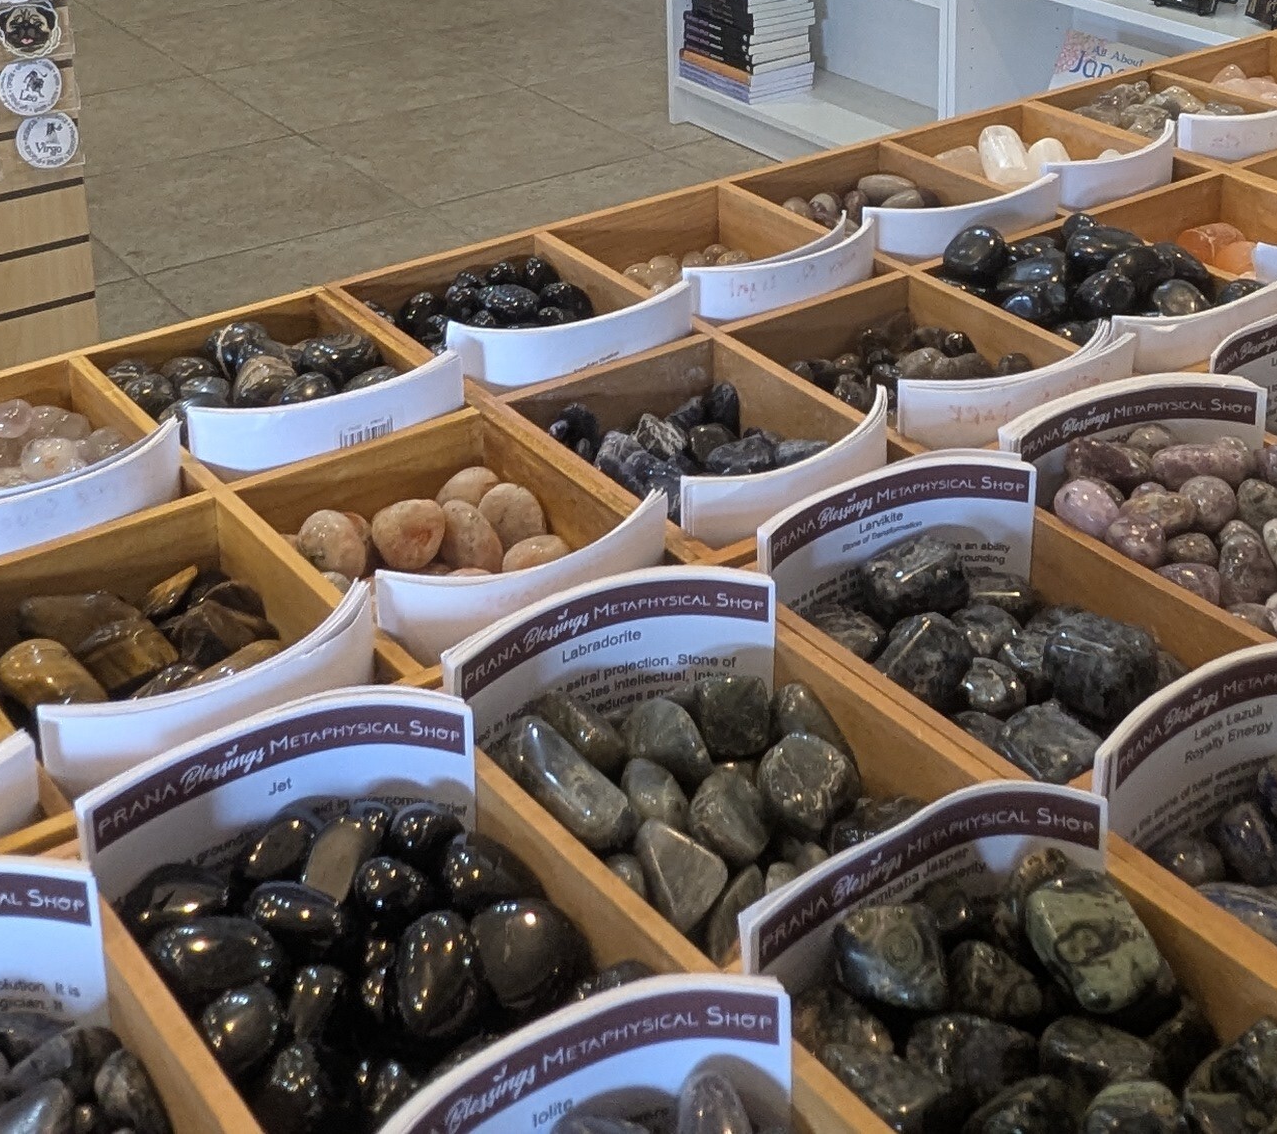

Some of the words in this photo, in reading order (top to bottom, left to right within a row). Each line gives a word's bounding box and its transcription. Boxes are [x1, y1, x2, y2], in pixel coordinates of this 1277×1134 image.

[1092, 45, 1109, 58] All
[1111, 52, 1144, 67] About
[19, 90, 37, 102] Leo
[35, 142, 62, 154] Virgo
[1114, 401, 1206, 419] METAPHYSICAL
[1211, 399, 1253, 413] SHOP
[773, 519, 816, 558] PRANA
[877, 479, 976, 503] METAPHYSICAL
[981, 477, 1025, 493] SHOP
[859, 511, 904, 534] Larvikite
[464, 643, 521, 689] PRANA
[594, 594, 710, 622] METAPHYSICAL
[716, 593, 764, 611] SHOP
[561, 629, 642, 664] Labradorite
[567, 670, 601, 691] astral
[677, 654, 717, 666] Stone
[722, 656, 737, 668] of
[1194, 721, 1223, 742] Lapis
[1226, 704, 1263, 727] Lazuli
[1227, 721, 1273, 742] Energy
[97, 783, 177, 837] PRANA
[269, 721, 405, 755] METAPHYSICAL
[409, 719, 461, 743] SHOP
[268, 777, 293, 796] Jet
[761, 896, 830, 957] PRANA
[907, 809, 1030, 858] METAPHYSICAL
[1036, 808, 1095, 833] SHOP
[28, 888, 86, 912] SHOP
[543, 1014, 698, 1073] METAPHYSICAL
[705, 1005, 773, 1030] SHOP
